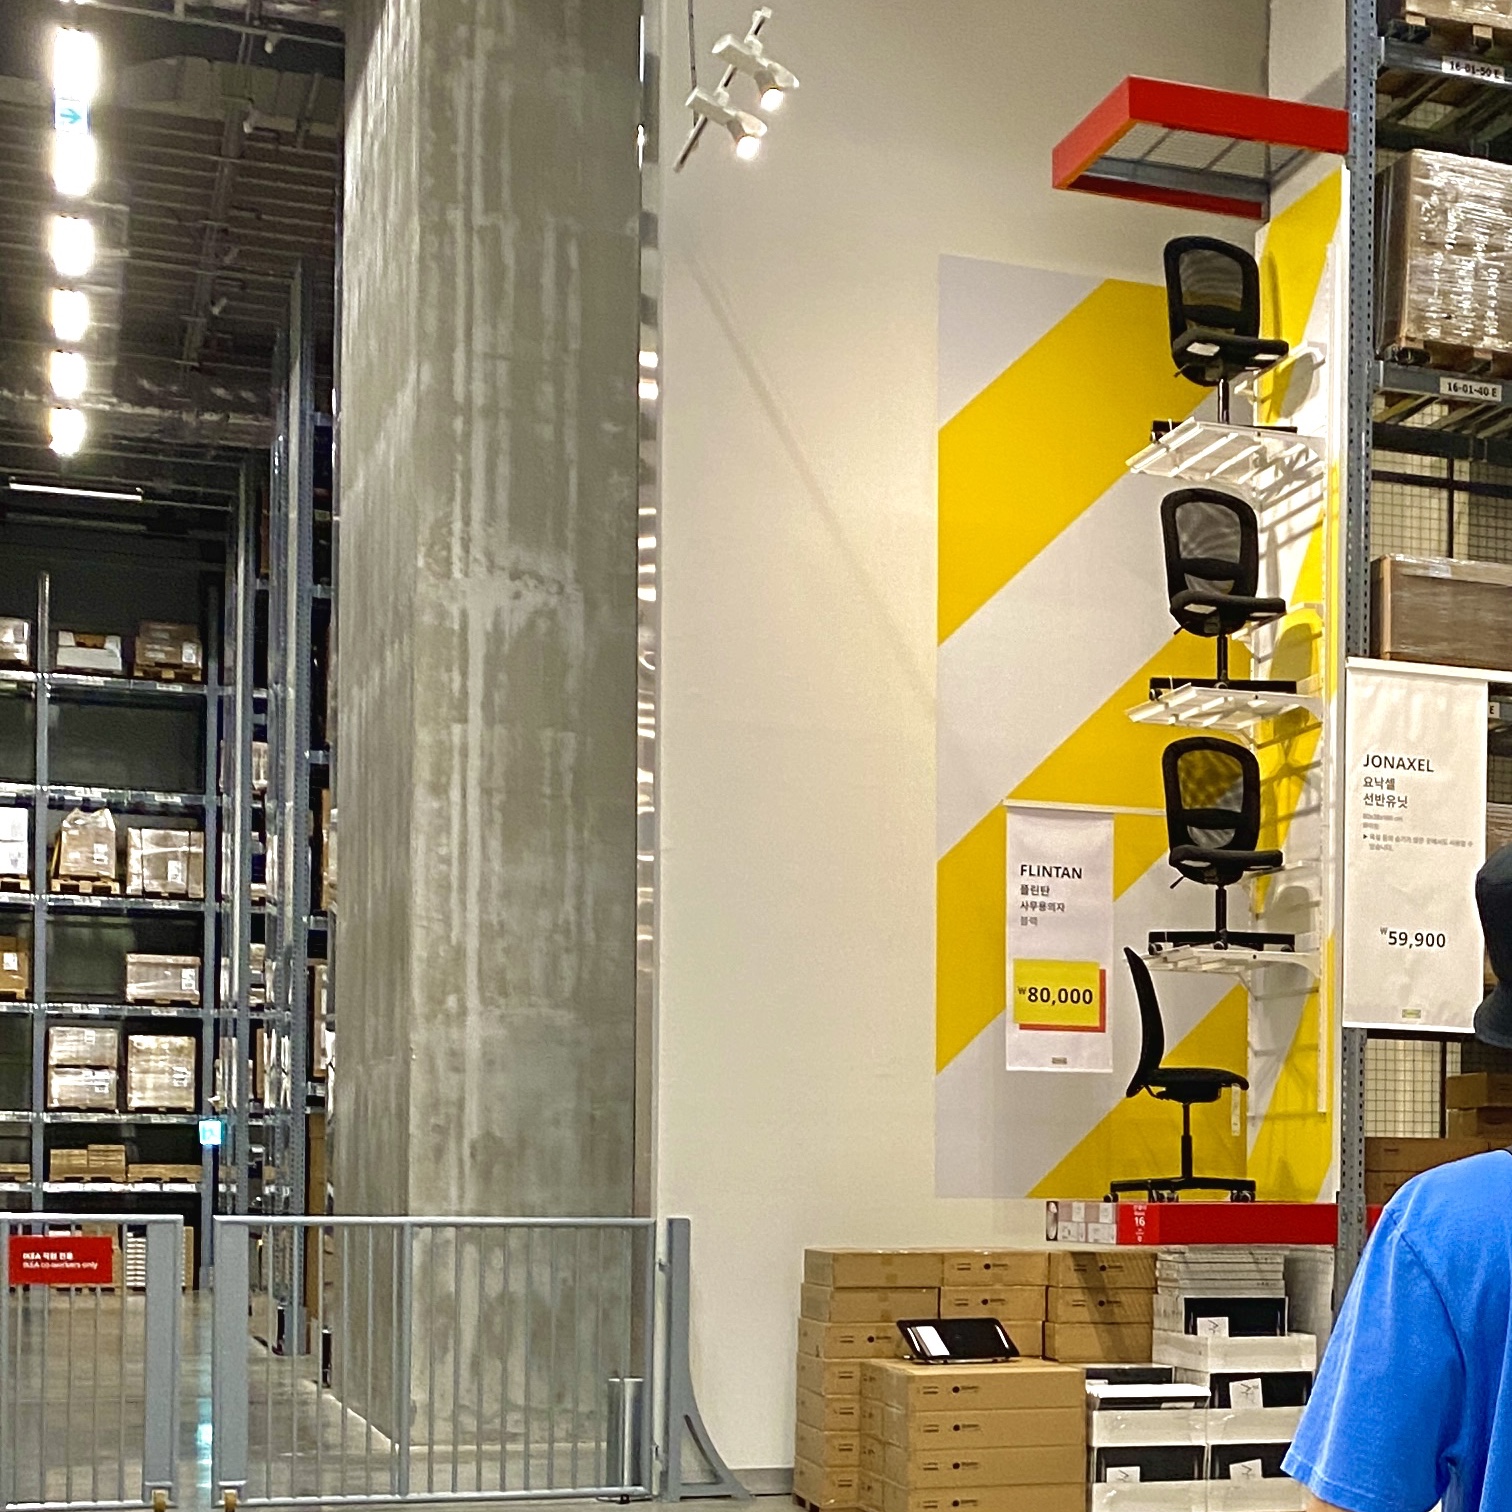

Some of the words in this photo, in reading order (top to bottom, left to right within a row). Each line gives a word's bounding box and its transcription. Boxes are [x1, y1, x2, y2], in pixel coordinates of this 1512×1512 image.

[1448, 382, 1490, 397] 16-01-40
[1363, 754, 1435, 773] JONAXEL
[1362, 776, 1396, 791] 요낙셀
[1362, 793, 1408, 809] 선반유닛
[1020, 864, 1082, 879] FLINTAN
[1134, 1216, 1146, 1227] 16
